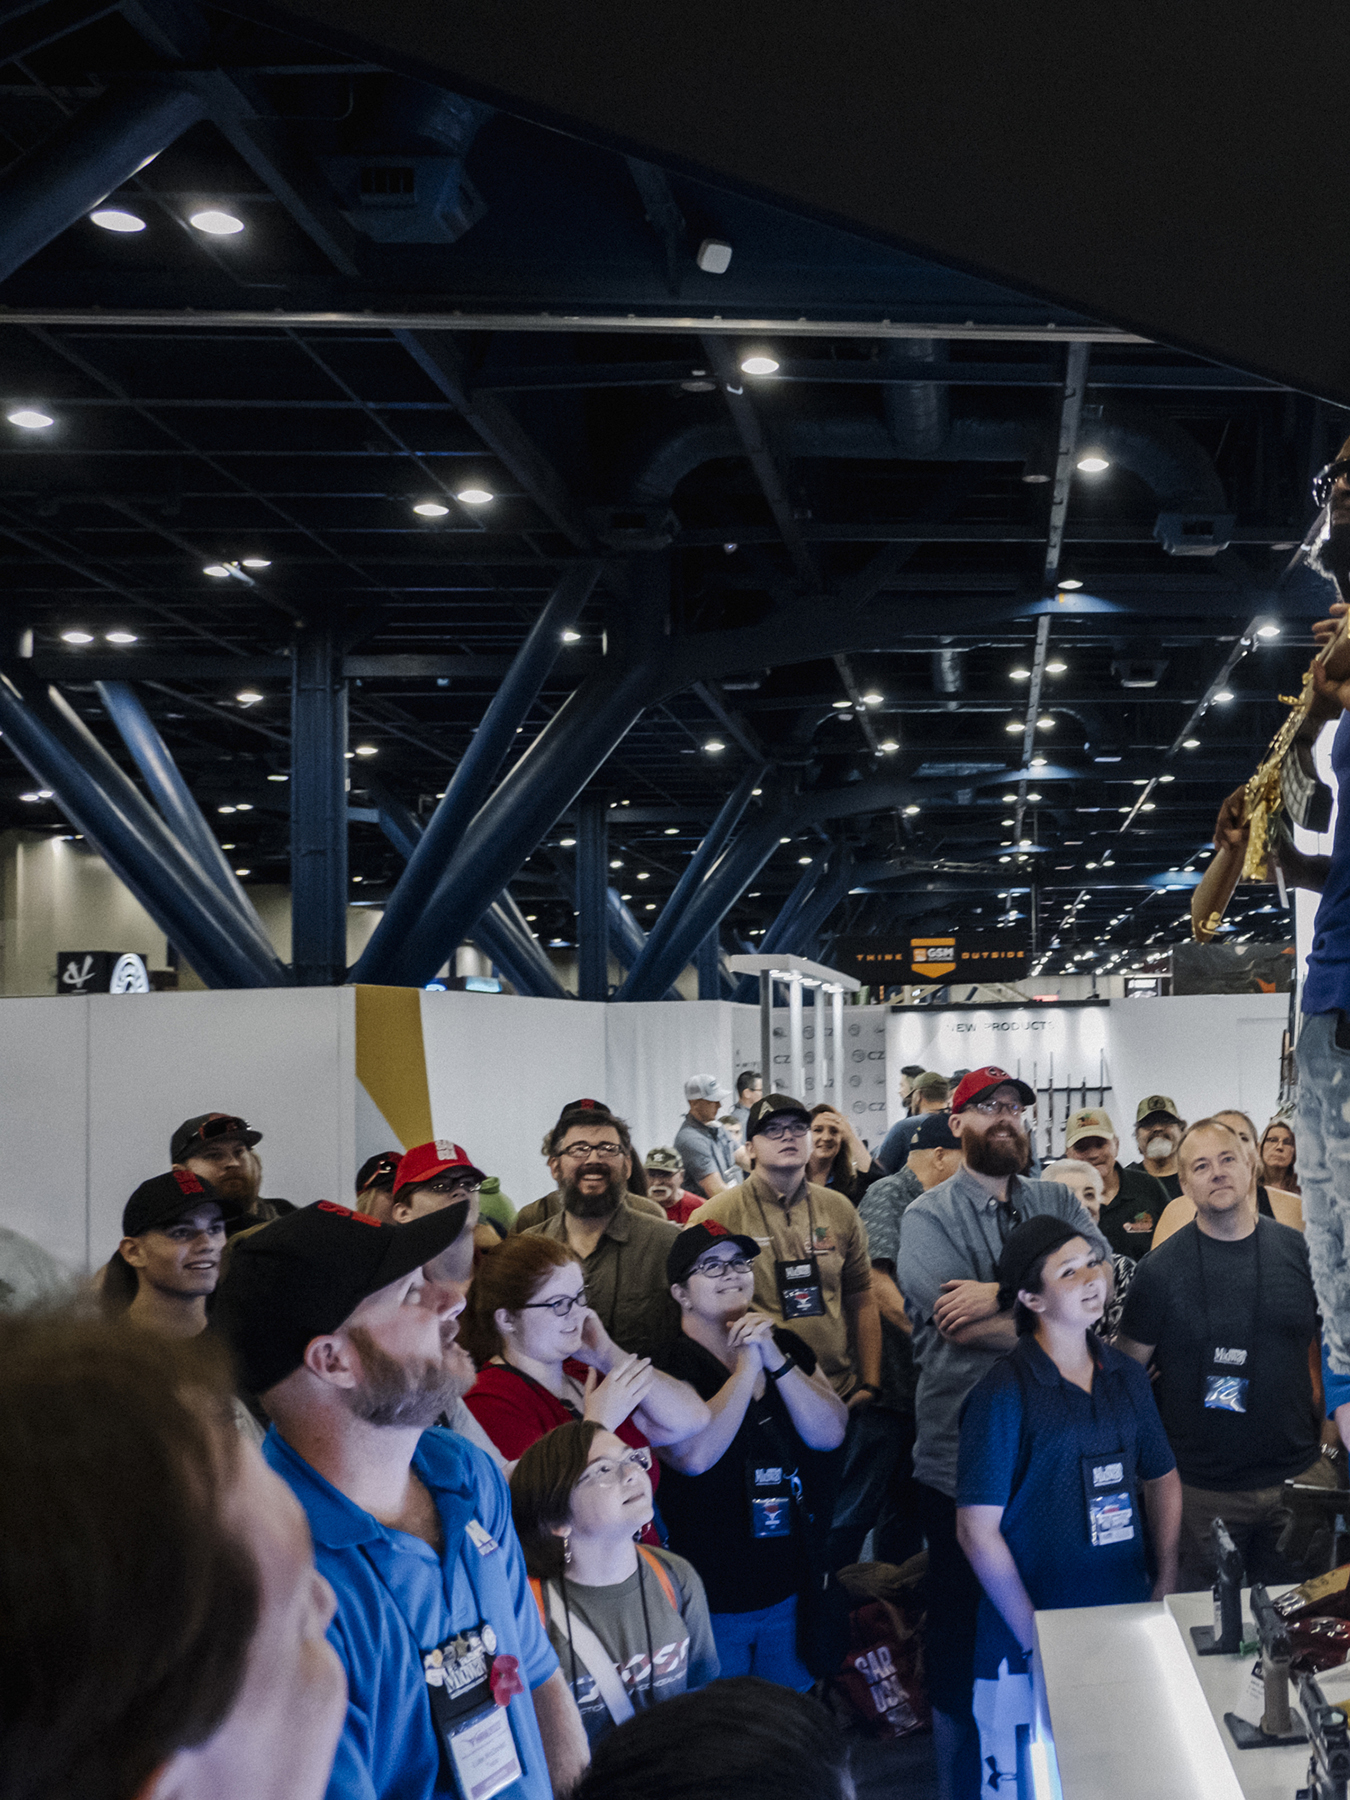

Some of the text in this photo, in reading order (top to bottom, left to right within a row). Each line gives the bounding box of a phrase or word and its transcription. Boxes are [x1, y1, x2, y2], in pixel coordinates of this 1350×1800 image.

[926, 947, 954, 957] GSM
[961, 951, 1025, 960] OUTSIDE
[773, 1054, 791, 1064] CZ
[867, 1050, 886, 1060] CZ
[868, 1101, 886, 1111] CZ
